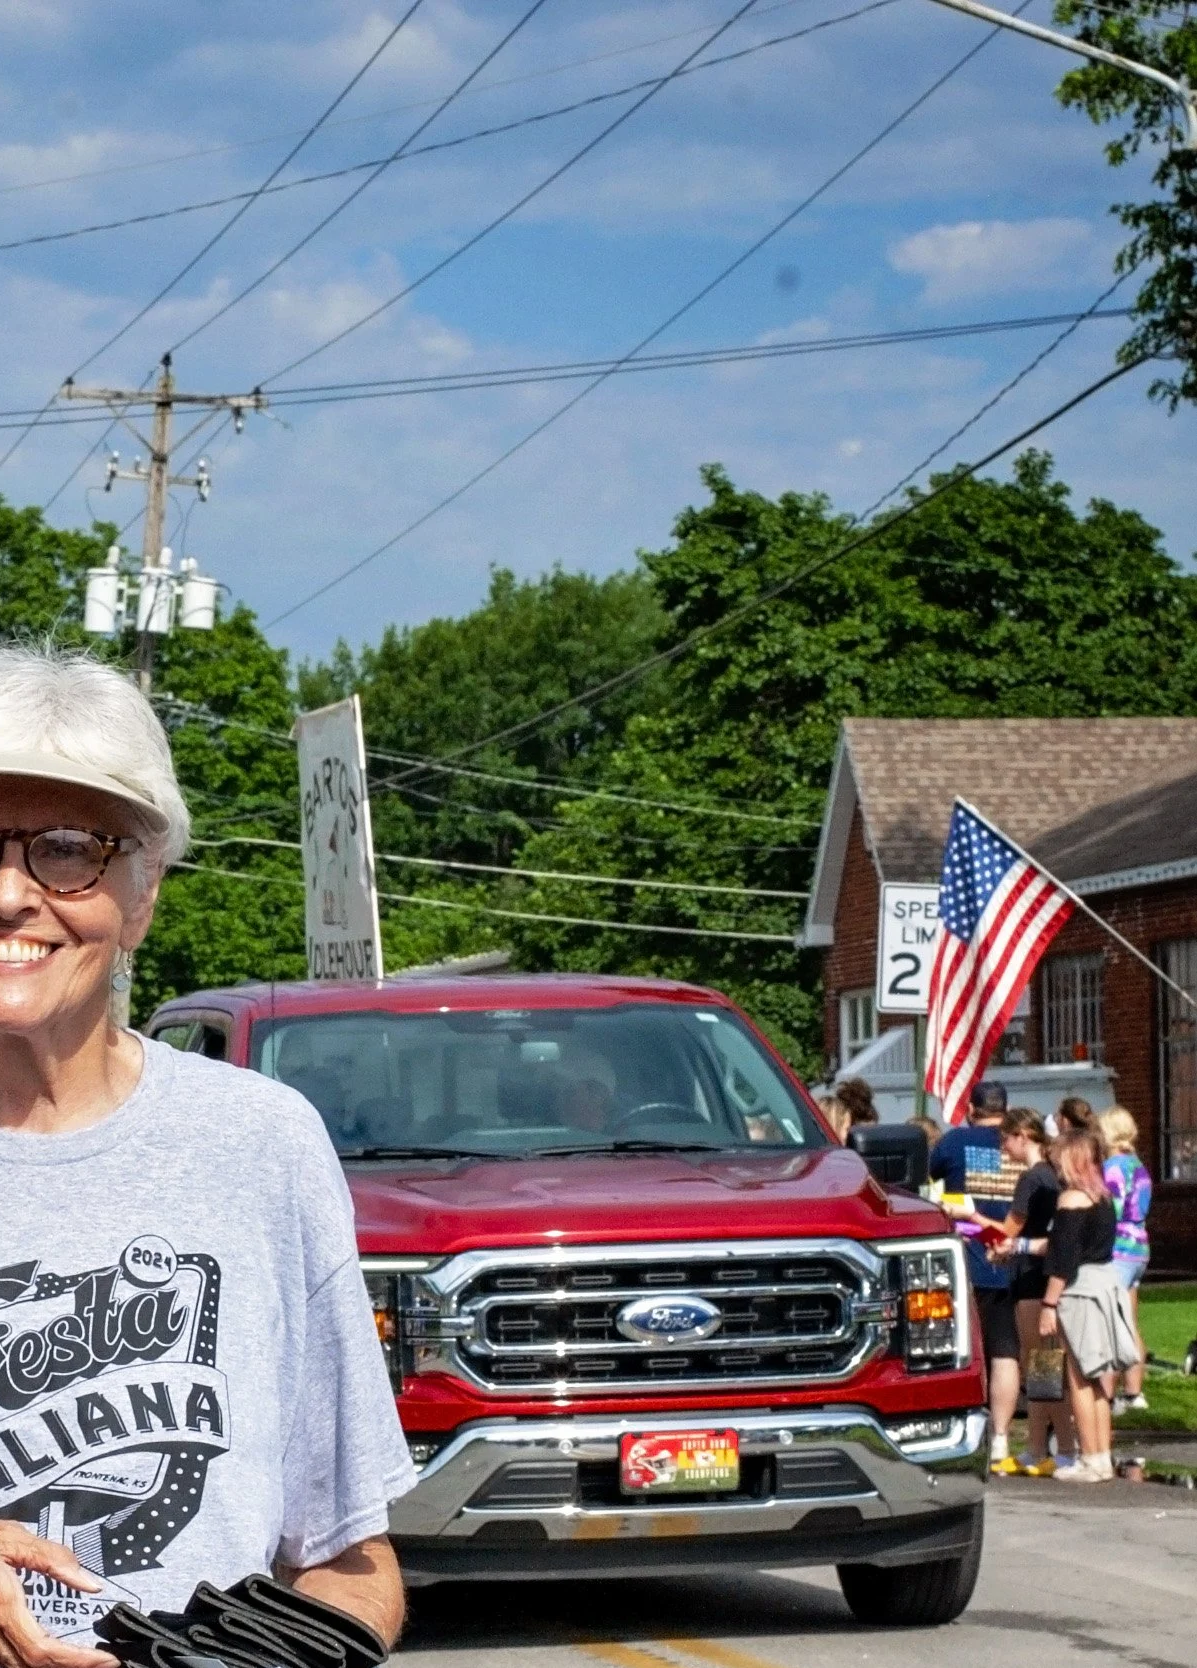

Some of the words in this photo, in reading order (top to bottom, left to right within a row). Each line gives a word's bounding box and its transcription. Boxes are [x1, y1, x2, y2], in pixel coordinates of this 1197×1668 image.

[893, 901, 939, 919] SPE
[902, 926, 936, 945] LIM
[888, 952, 921, 995] 2
[131, 1246, 172, 1273] 2024
[74, 1470, 129, 1487] FRONTENAC,
[132, 1480, 147, 1488] KS
[50, 1616, 77, 1626] 1999
